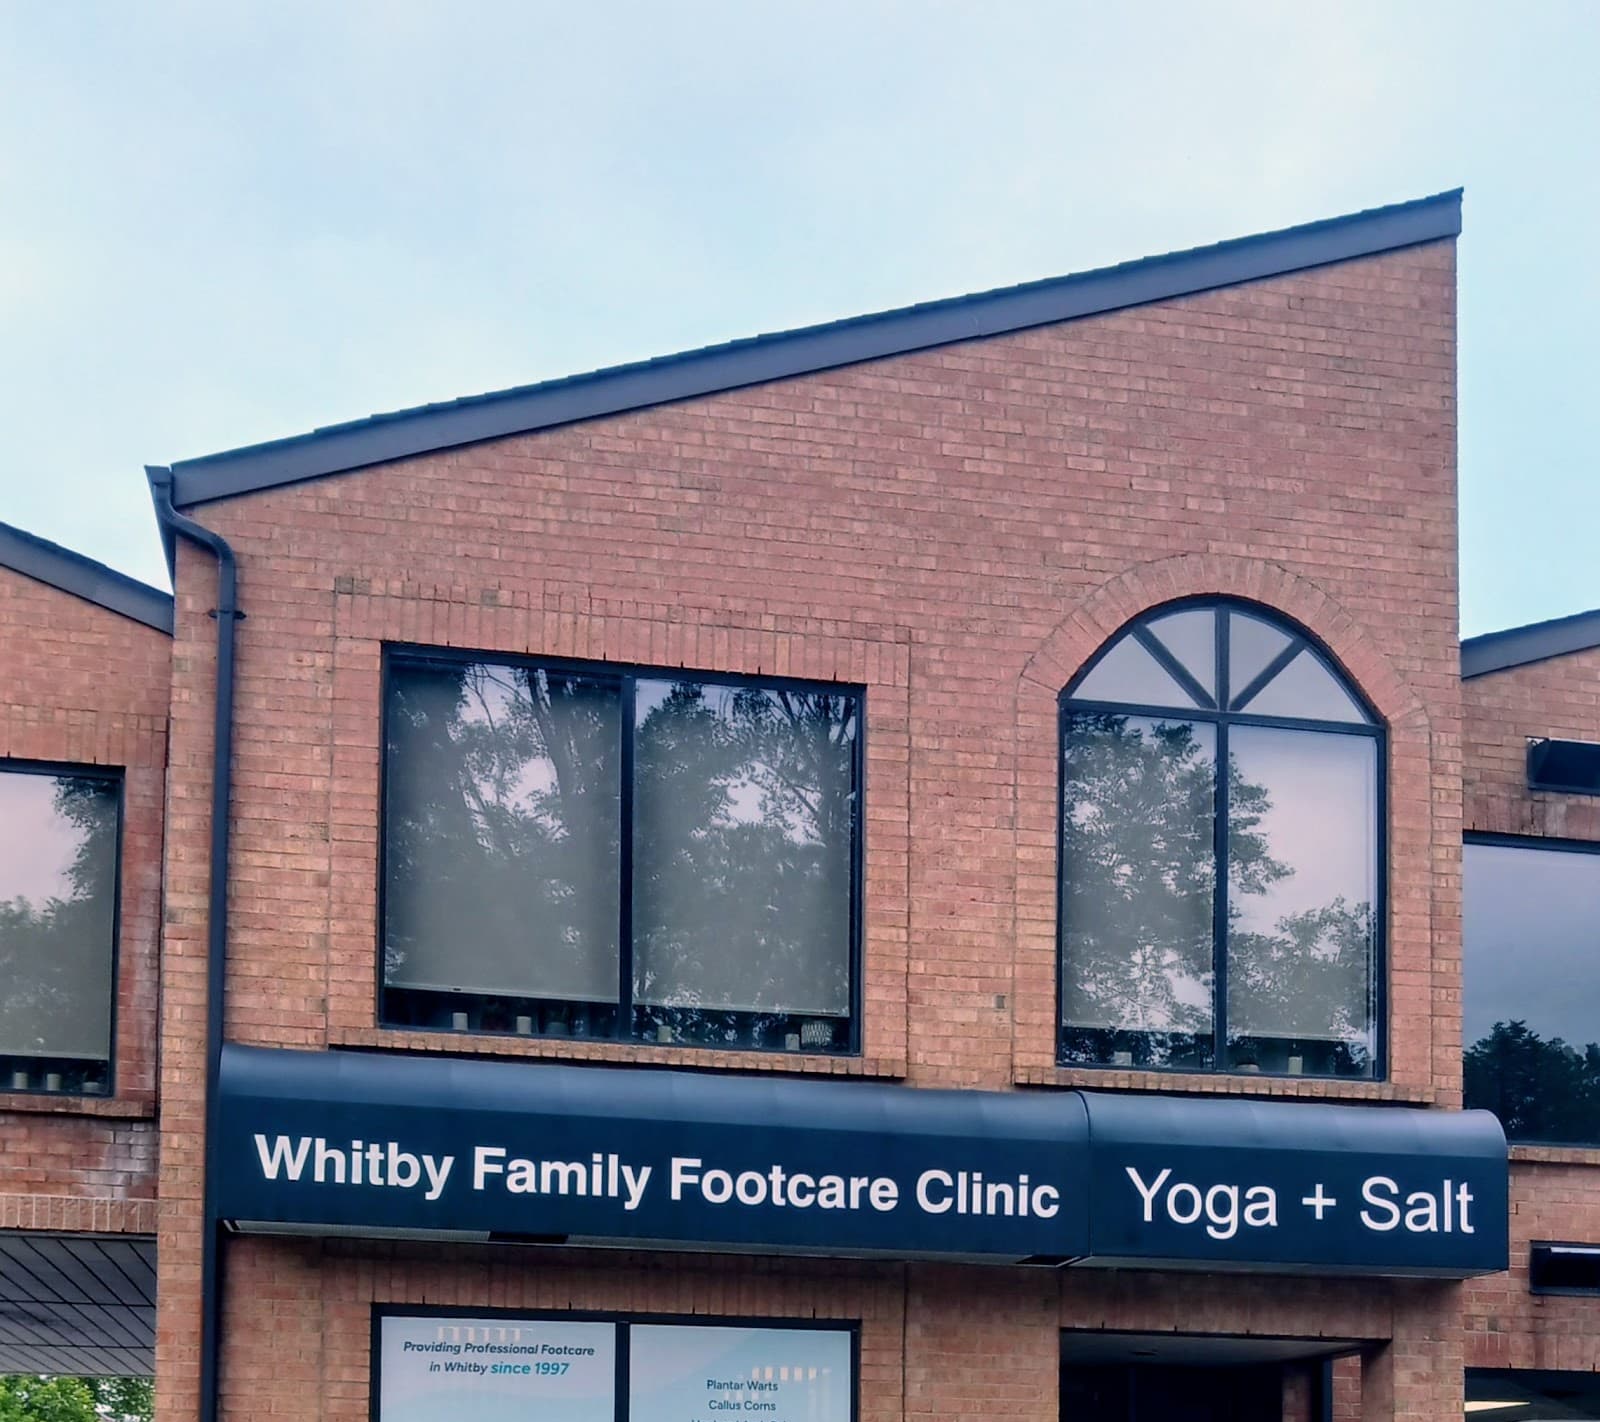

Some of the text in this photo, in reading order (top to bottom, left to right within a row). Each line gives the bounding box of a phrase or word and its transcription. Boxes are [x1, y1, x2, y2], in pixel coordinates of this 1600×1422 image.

[254, 1134, 1059, 1217] Whitby Family Footcare Clinic
[1126, 1167, 1474, 1239] Yoga + Salt
[403, 1340, 595, 1355] Providing Professional Footcare
[429, 1360, 570, 1375] in Whitby since 1997
[706, 1379, 779, 1392] Plantar Warts
[708, 1399, 777, 1411] Callus Corns
